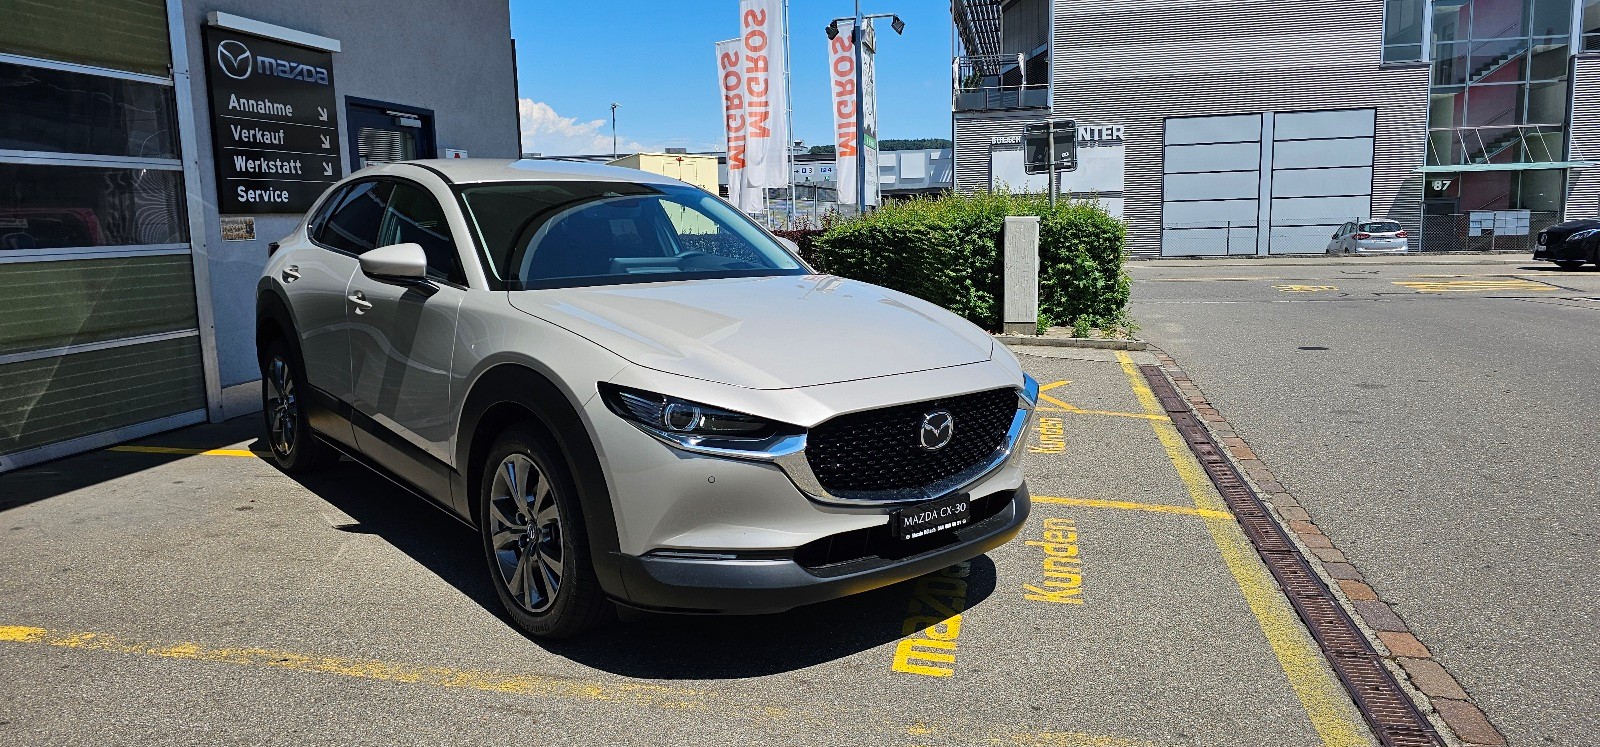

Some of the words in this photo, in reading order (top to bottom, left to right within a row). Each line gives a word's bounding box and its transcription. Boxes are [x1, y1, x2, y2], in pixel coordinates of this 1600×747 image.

[228, 93, 293, 117] Annahme
[230, 124, 285, 145] Verkauf
[1078, 125, 1124, 141] NTER
[233, 155, 302, 175] Werkstatt
[237, 185, 289, 203] Service
[1432, 180, 1452, 191] 87
[1027, 417, 1066, 454] Kunden
[903, 509, 938, 528] MAZDA
[940, 502, 967, 517] CX-30
[1023, 517, 1083, 605] Kunden
